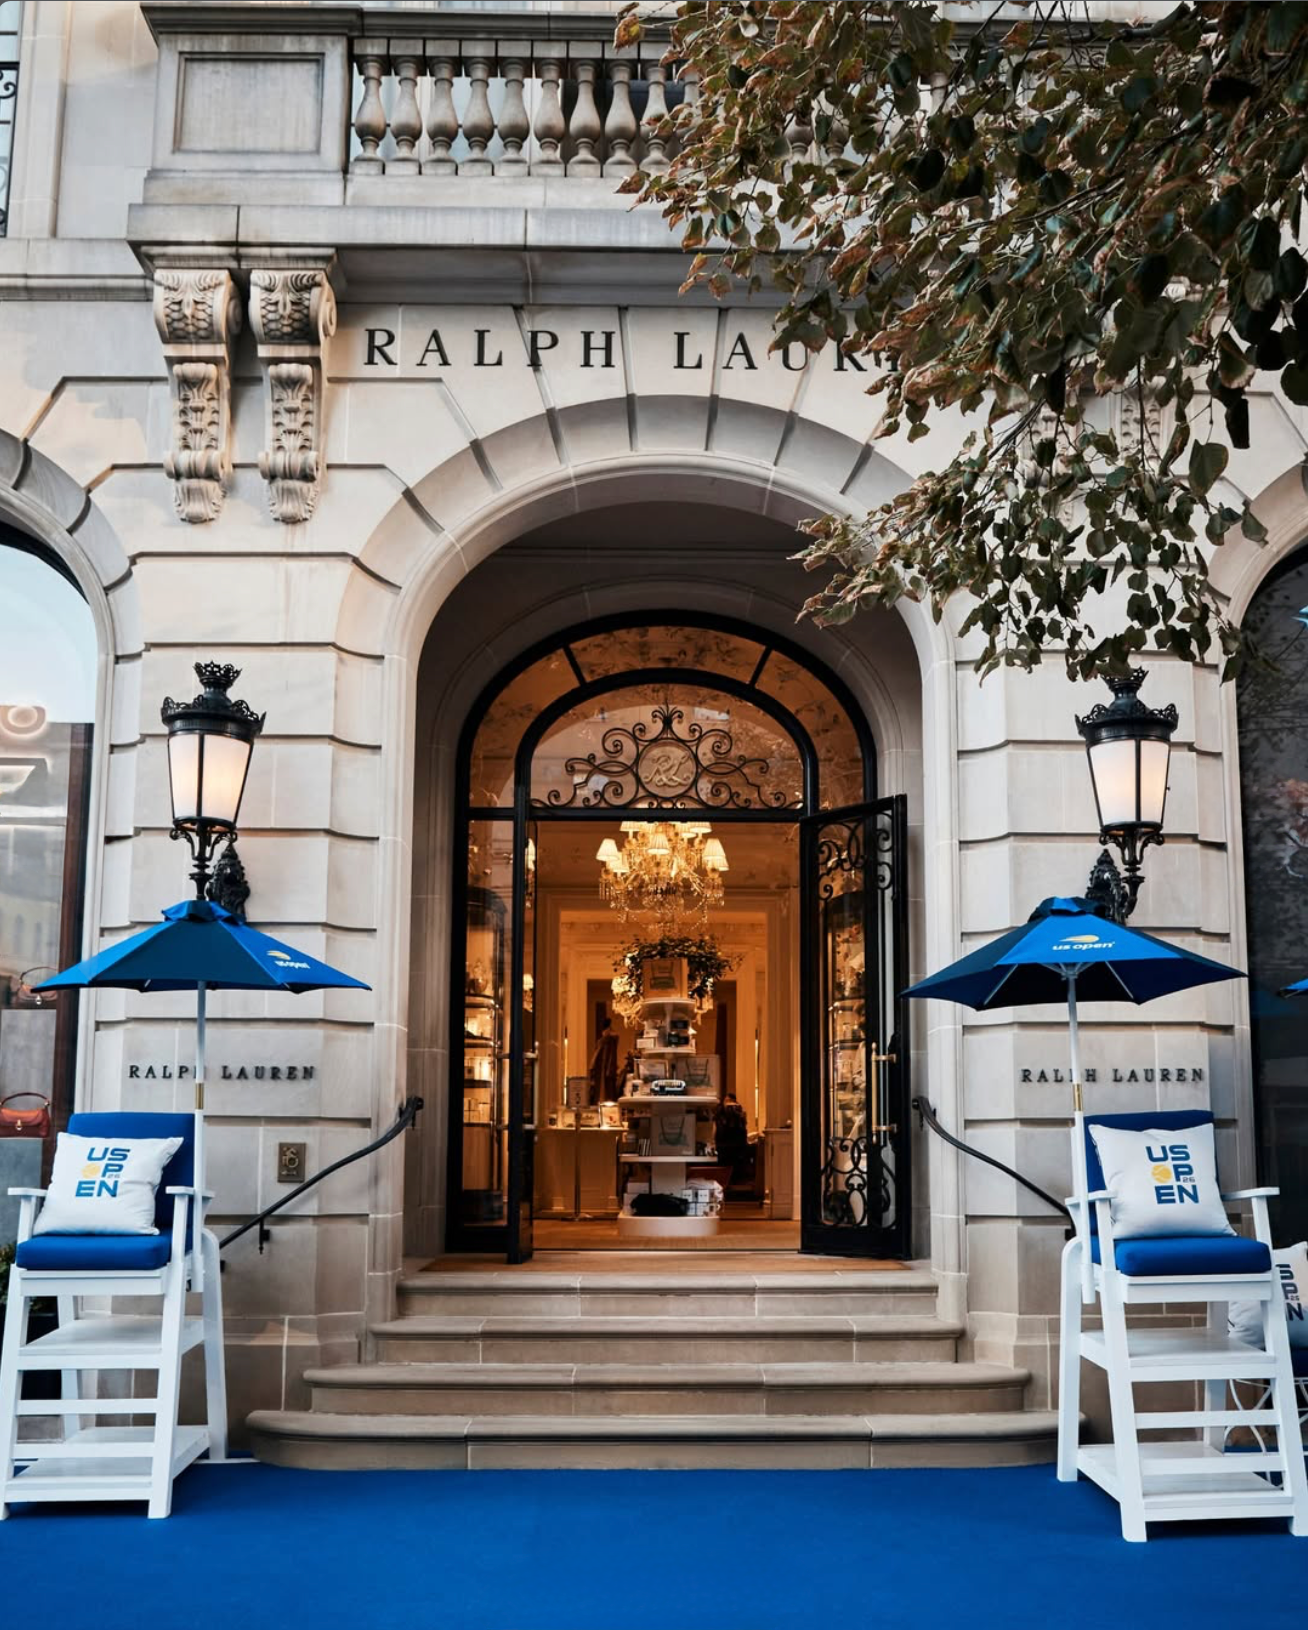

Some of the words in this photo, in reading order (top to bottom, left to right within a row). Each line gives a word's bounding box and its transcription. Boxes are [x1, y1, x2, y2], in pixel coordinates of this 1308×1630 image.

[363, 328, 616, 368] RALPH
[672, 331, 899, 372] LAUR
[220, 1065, 315, 1080] LAUREN
[1021, 1068, 1097, 1083] RALH
[1112, 1068, 1203, 1083] LAUREN
[87, 1147, 131, 1162] US
[1145, 1144, 1191, 1163] US
[75, 1180, 119, 1198] EN
[1154, 1184, 1200, 1205] EN
[1285, 1302, 1305, 1321] N
